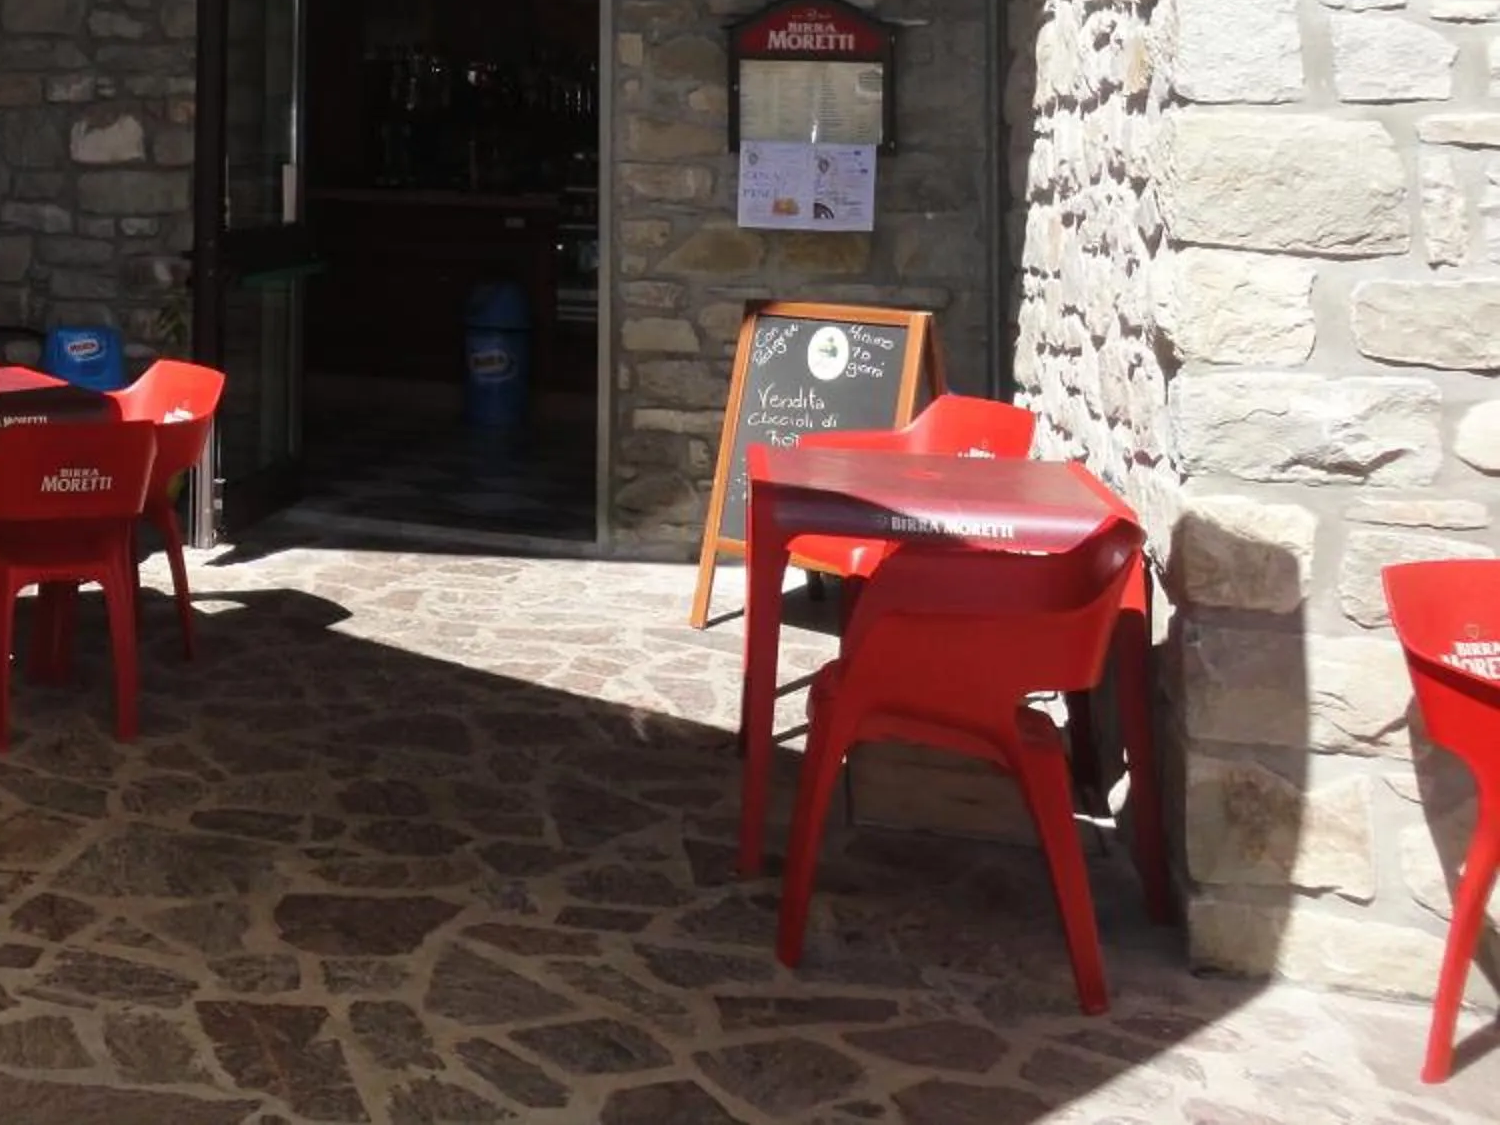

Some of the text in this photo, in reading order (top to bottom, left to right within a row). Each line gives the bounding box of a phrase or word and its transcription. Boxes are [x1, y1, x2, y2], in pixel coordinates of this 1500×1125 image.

[787, 22, 837, 33] BIRRA
[767, 30, 855, 50] MORETTI
[757, 383, 825, 409] Vendita
[821, 413, 838, 428] di
[60, 468, 99, 477] BIRRA
[41, 475, 113, 492] MORETTI
[891, 516, 1014, 538] BIRRA MORETTI
